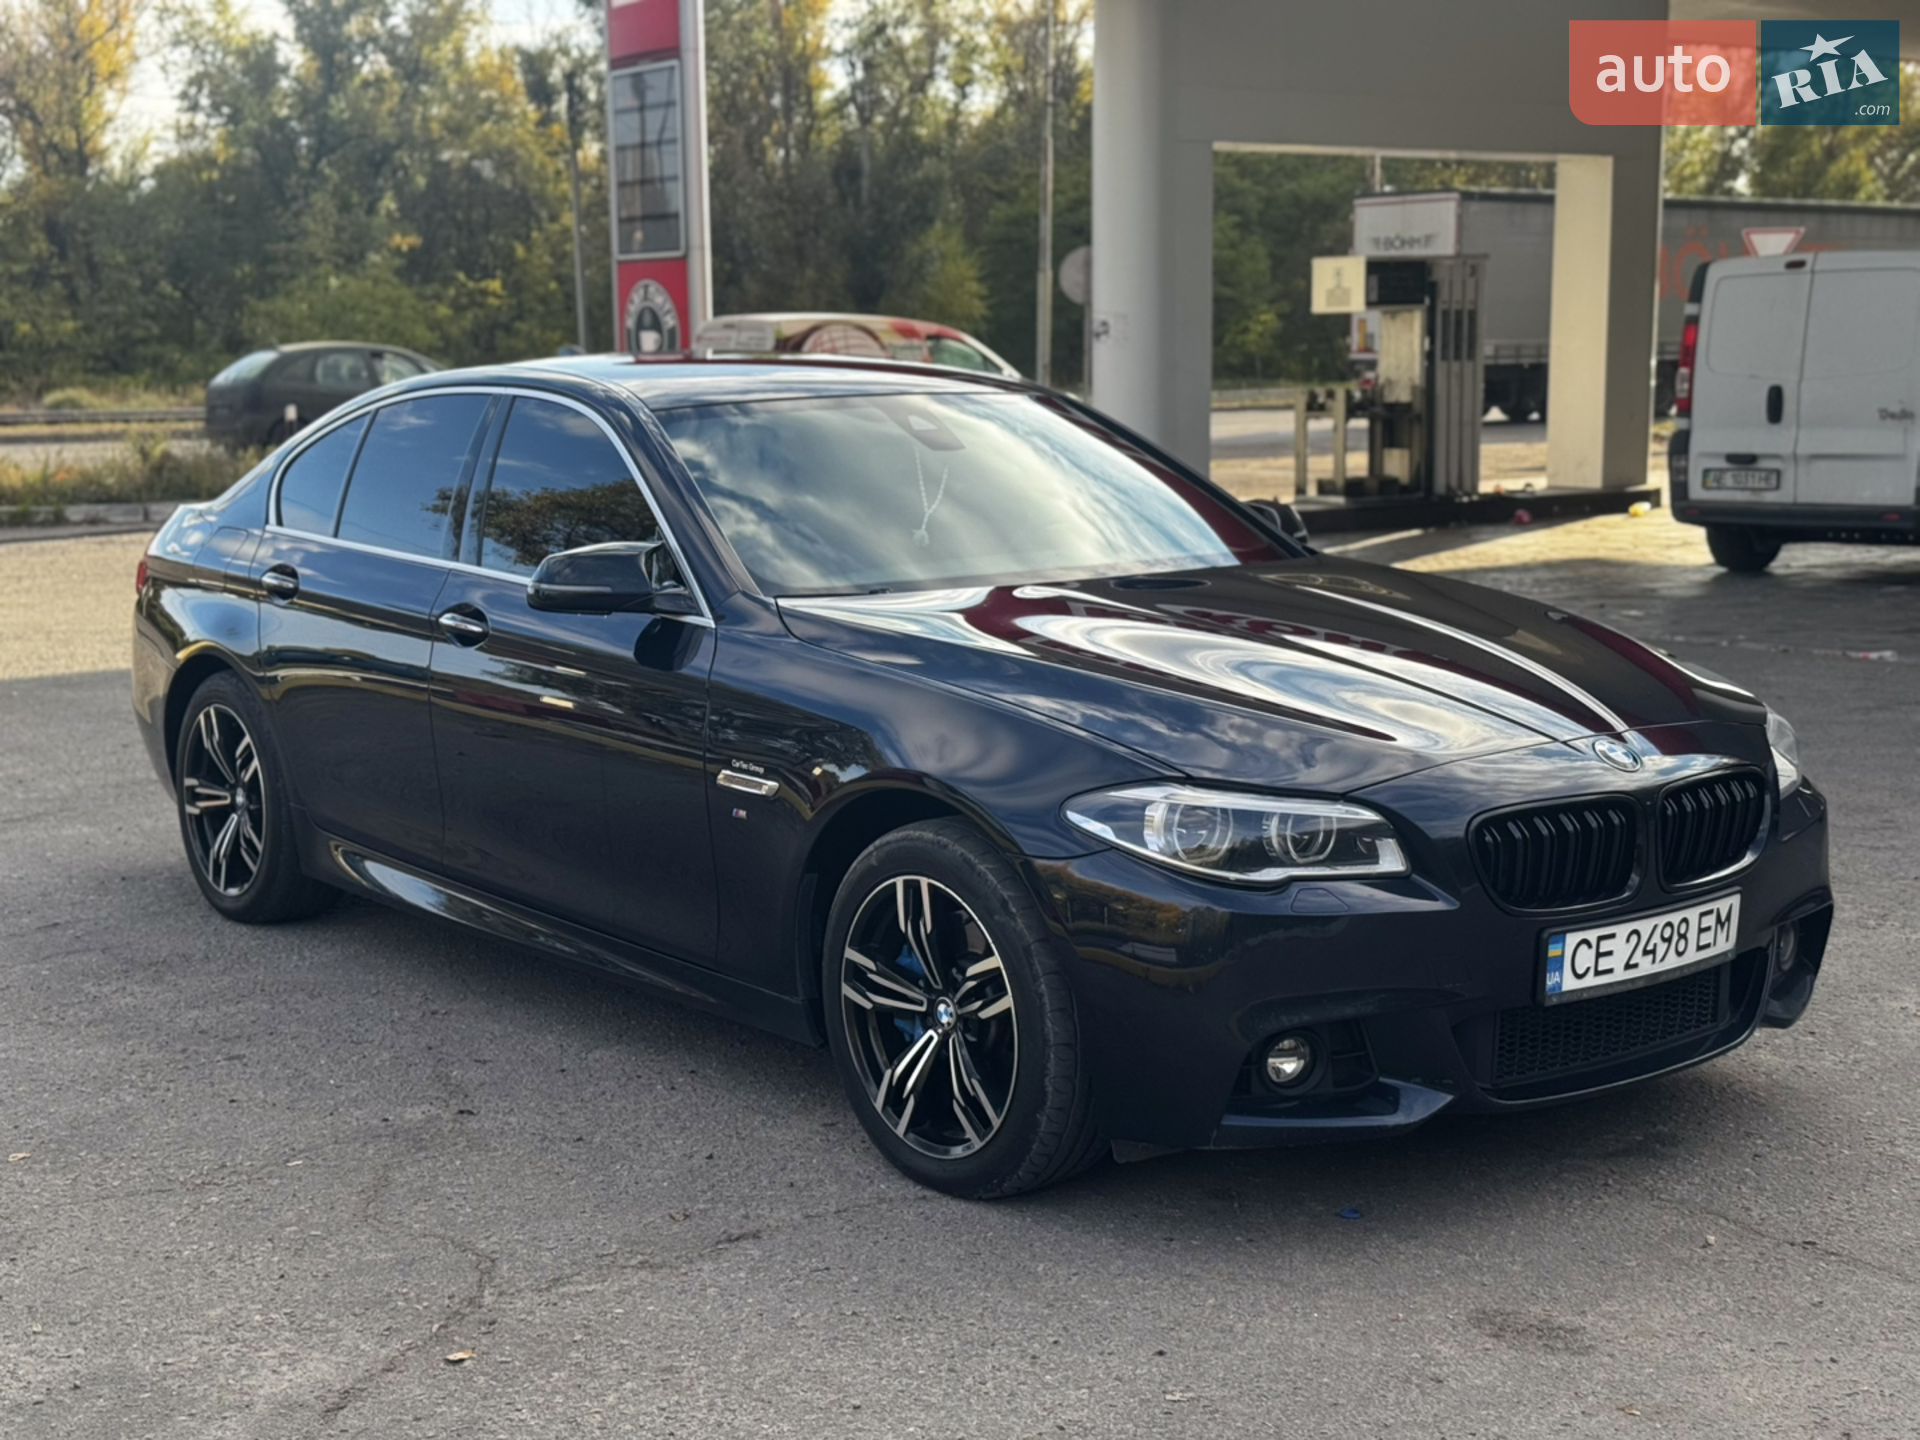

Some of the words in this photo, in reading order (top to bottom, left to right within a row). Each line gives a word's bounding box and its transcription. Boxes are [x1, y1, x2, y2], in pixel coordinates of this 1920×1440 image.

[1570, 932, 1616, 980] CE
[1624, 917, 1690, 971] 2498
[1696, 903, 1733, 952] EM
[1546, 972, 1561, 985] UA
